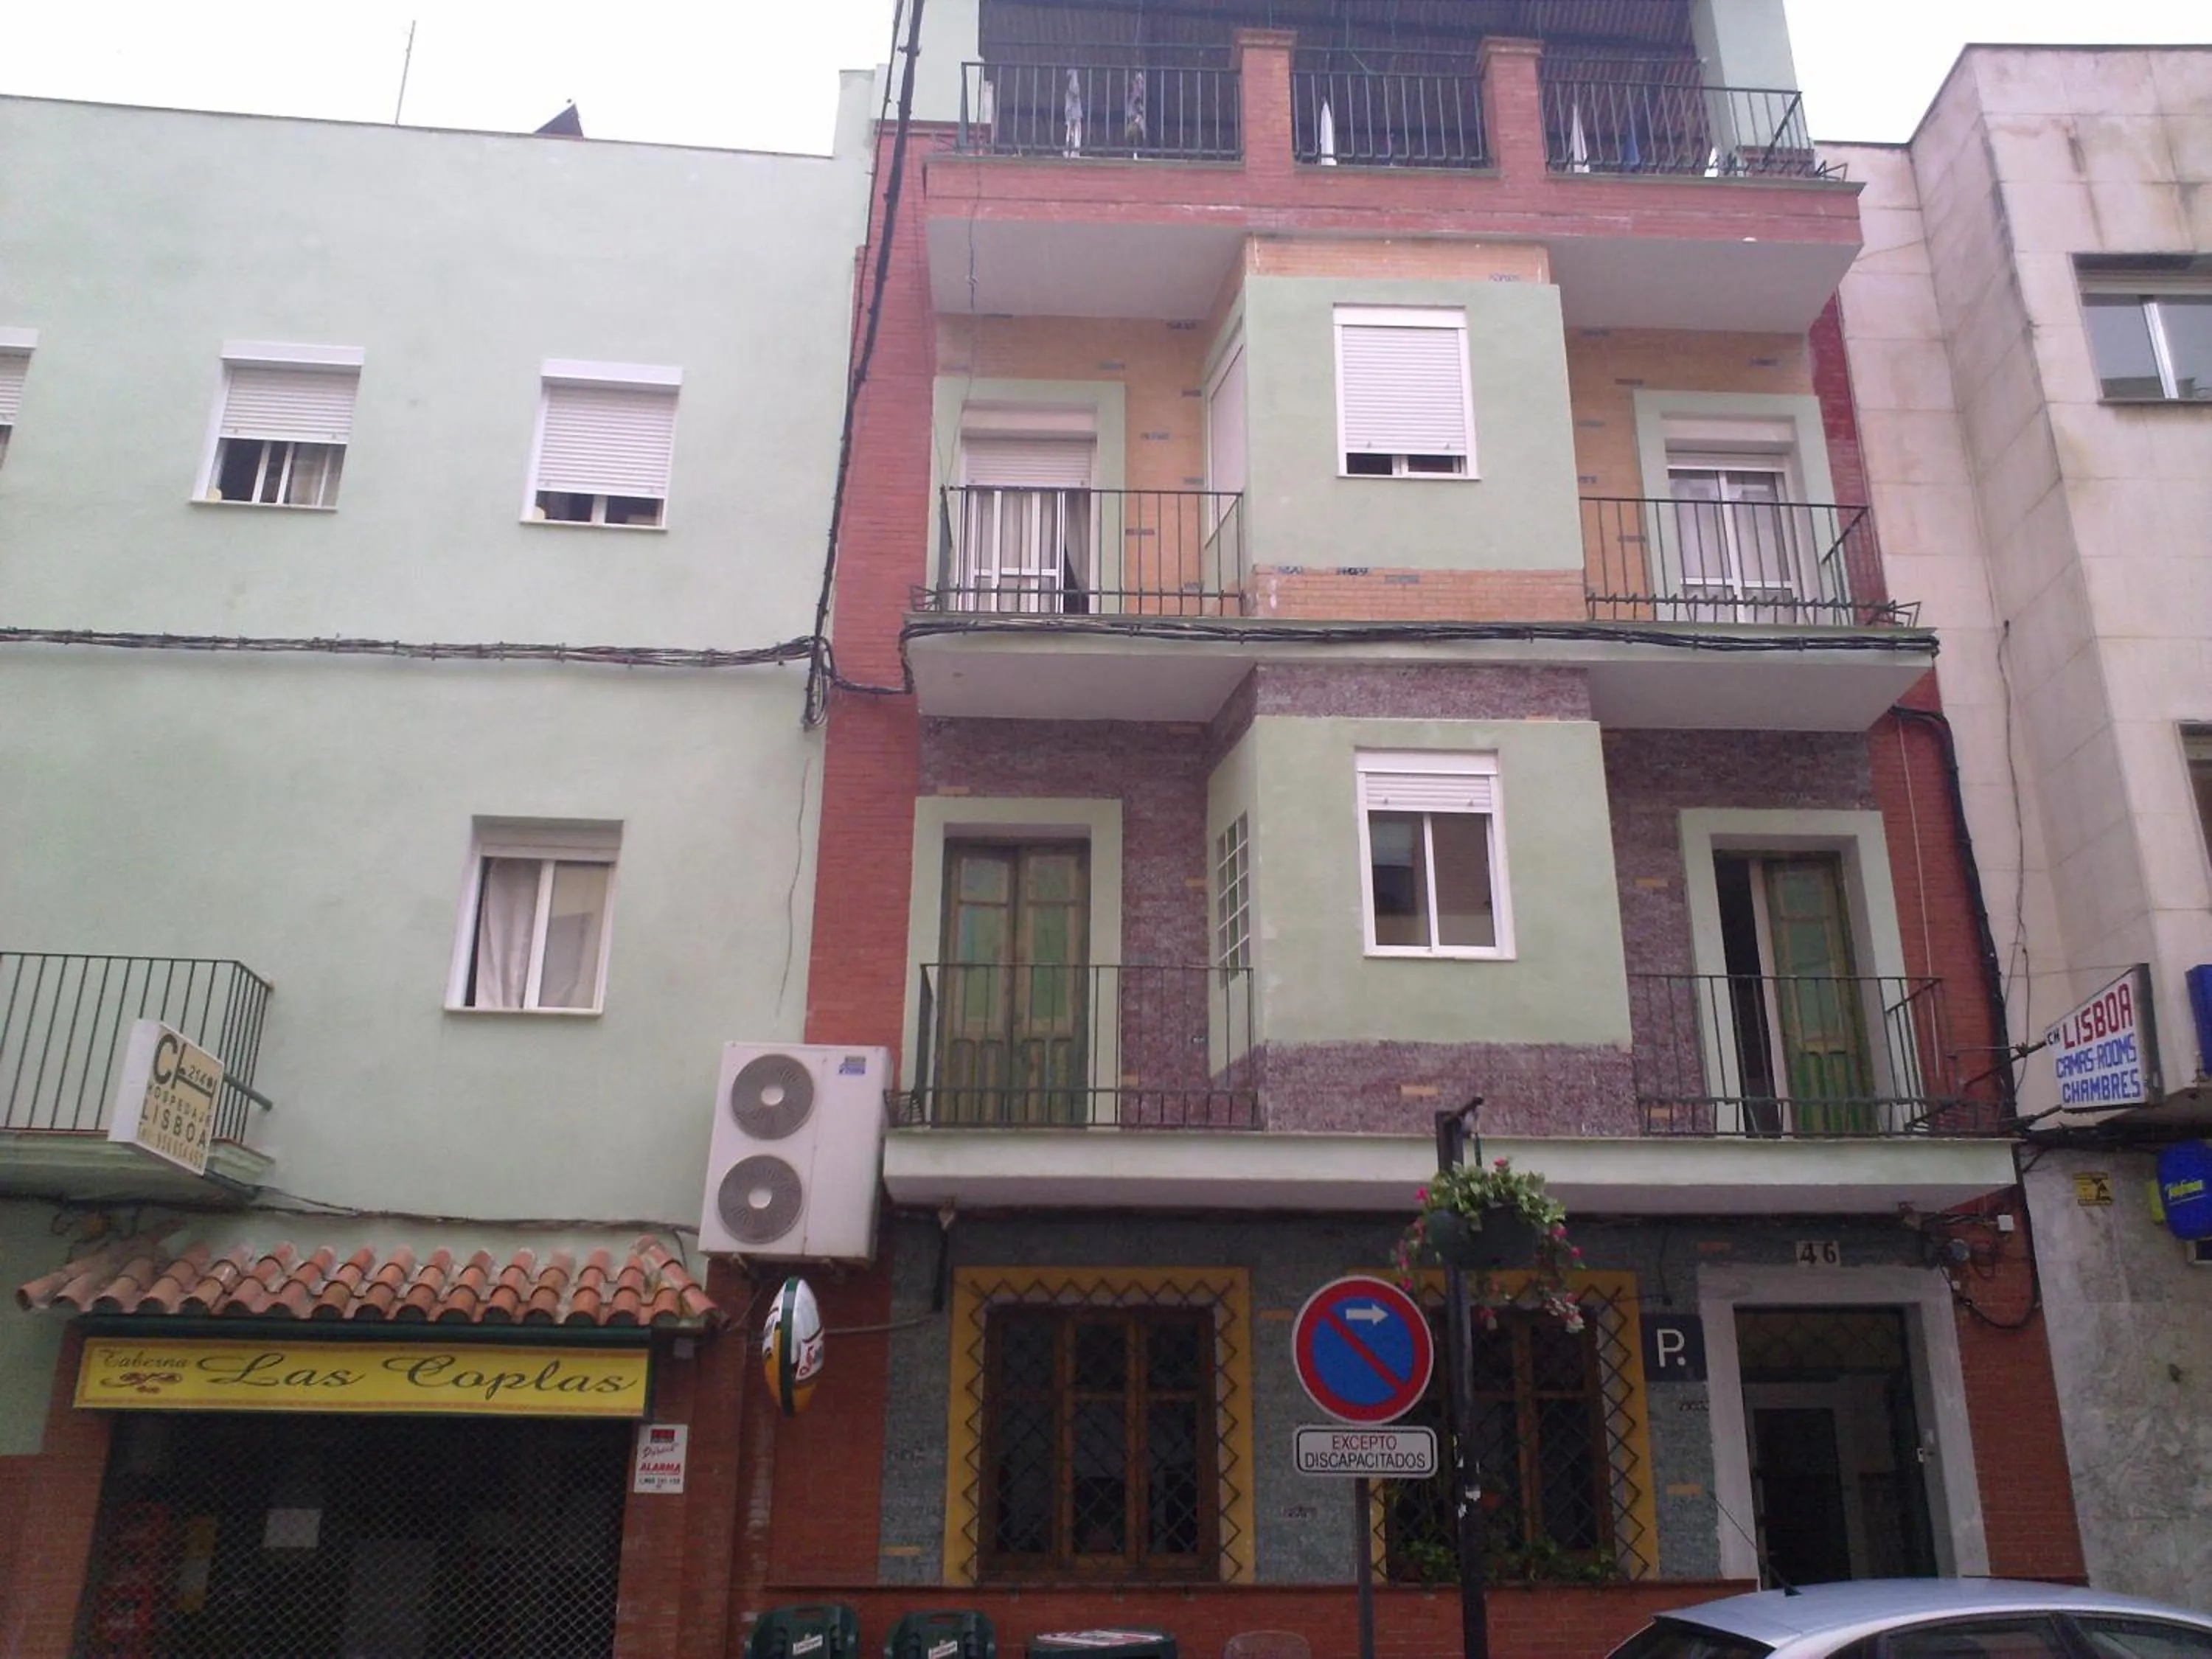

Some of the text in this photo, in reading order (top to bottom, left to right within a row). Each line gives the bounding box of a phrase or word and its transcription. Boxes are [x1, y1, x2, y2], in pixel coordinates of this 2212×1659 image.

[2063, 984, 2133, 1049] LISBOA
[2062, 1068, 2141, 1104] CHAMBRES
[147, 1083, 212, 1128] HOSPEDAJE
[141, 1096, 206, 1148] LISBOA
[1799, 1242, 1837, 1265] 46
[97, 1348, 189, 1369] Taberna
[196, 1352, 639, 1401] Las Coplas
[1332, 1435, 1398, 1450] EXCEPTO
[639, 1462, 681, 1473] ALARMA
[1304, 1452, 1426, 1469] DISCAPACITADOS
